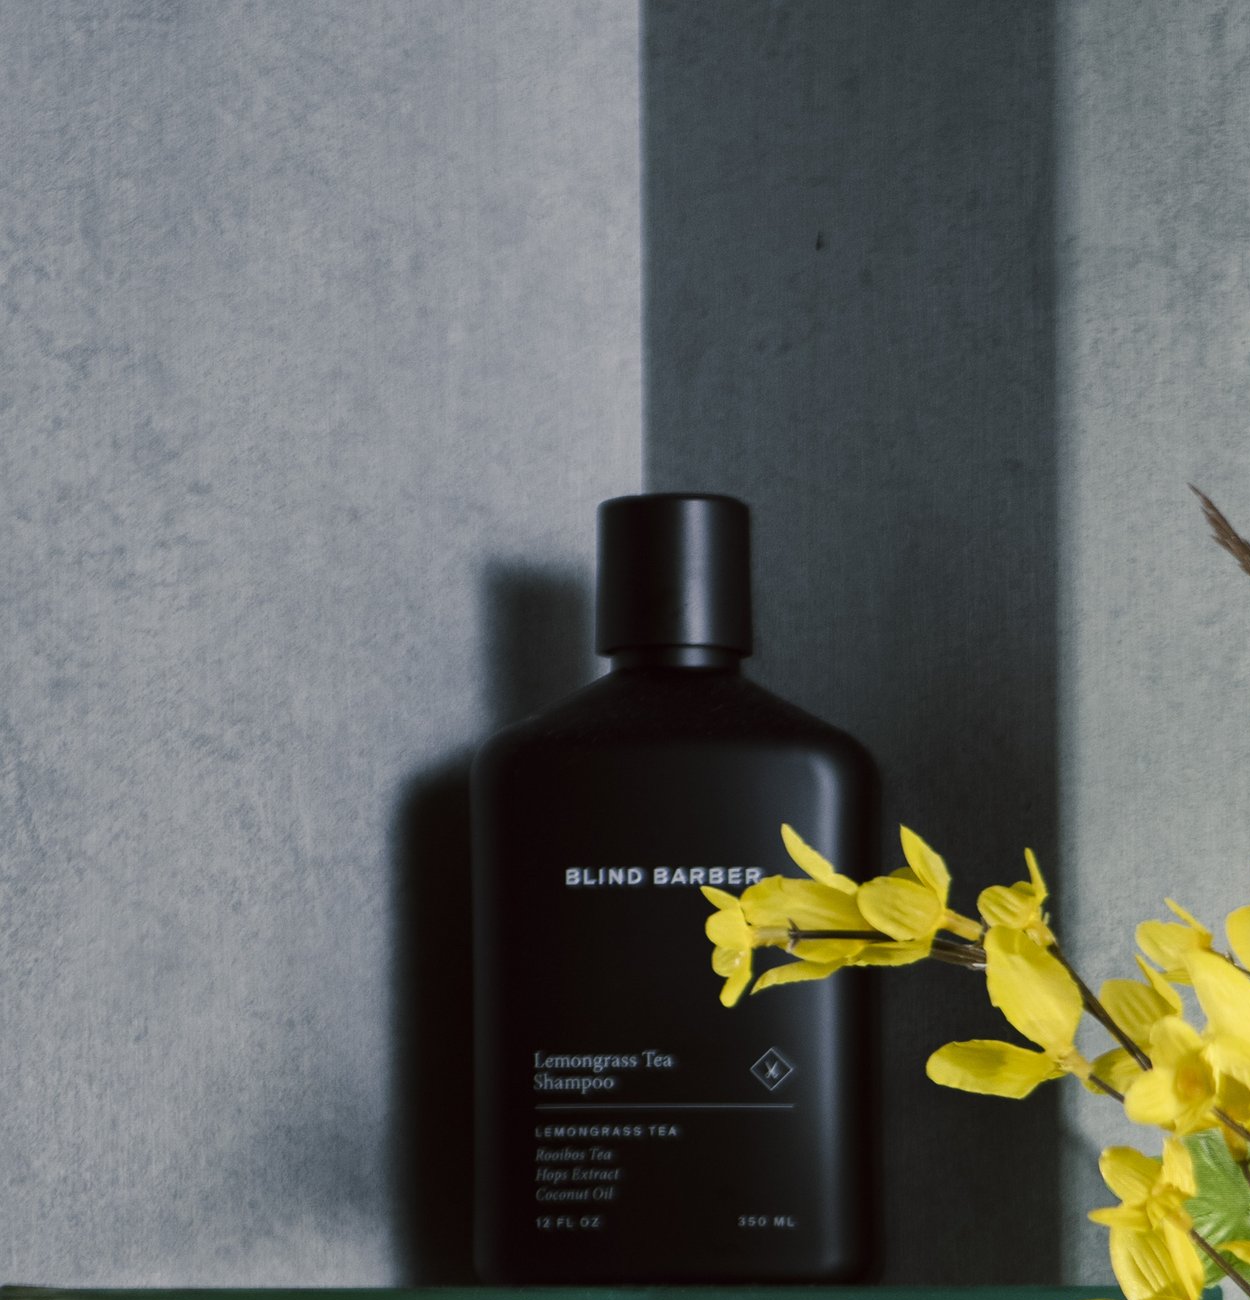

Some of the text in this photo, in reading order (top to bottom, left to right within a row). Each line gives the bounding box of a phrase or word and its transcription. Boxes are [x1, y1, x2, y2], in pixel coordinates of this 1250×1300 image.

[565, 867, 763, 886] BLIND BARBER
[534, 1051, 673, 1073] Lemongrass Tea
[533, 1074, 615, 1094] Shampoo
[535, 1126, 678, 1138] LEMONGRASS TEA
[535, 1149, 613, 1162] Rooibos Tea
[535, 1167, 620, 1185] Hops Extract
[535, 1187, 615, 1202] Coconut Oil
[535, 1217, 601, 1229] 12 FL OZ
[737, 1216, 796, 1227] 350 ML
